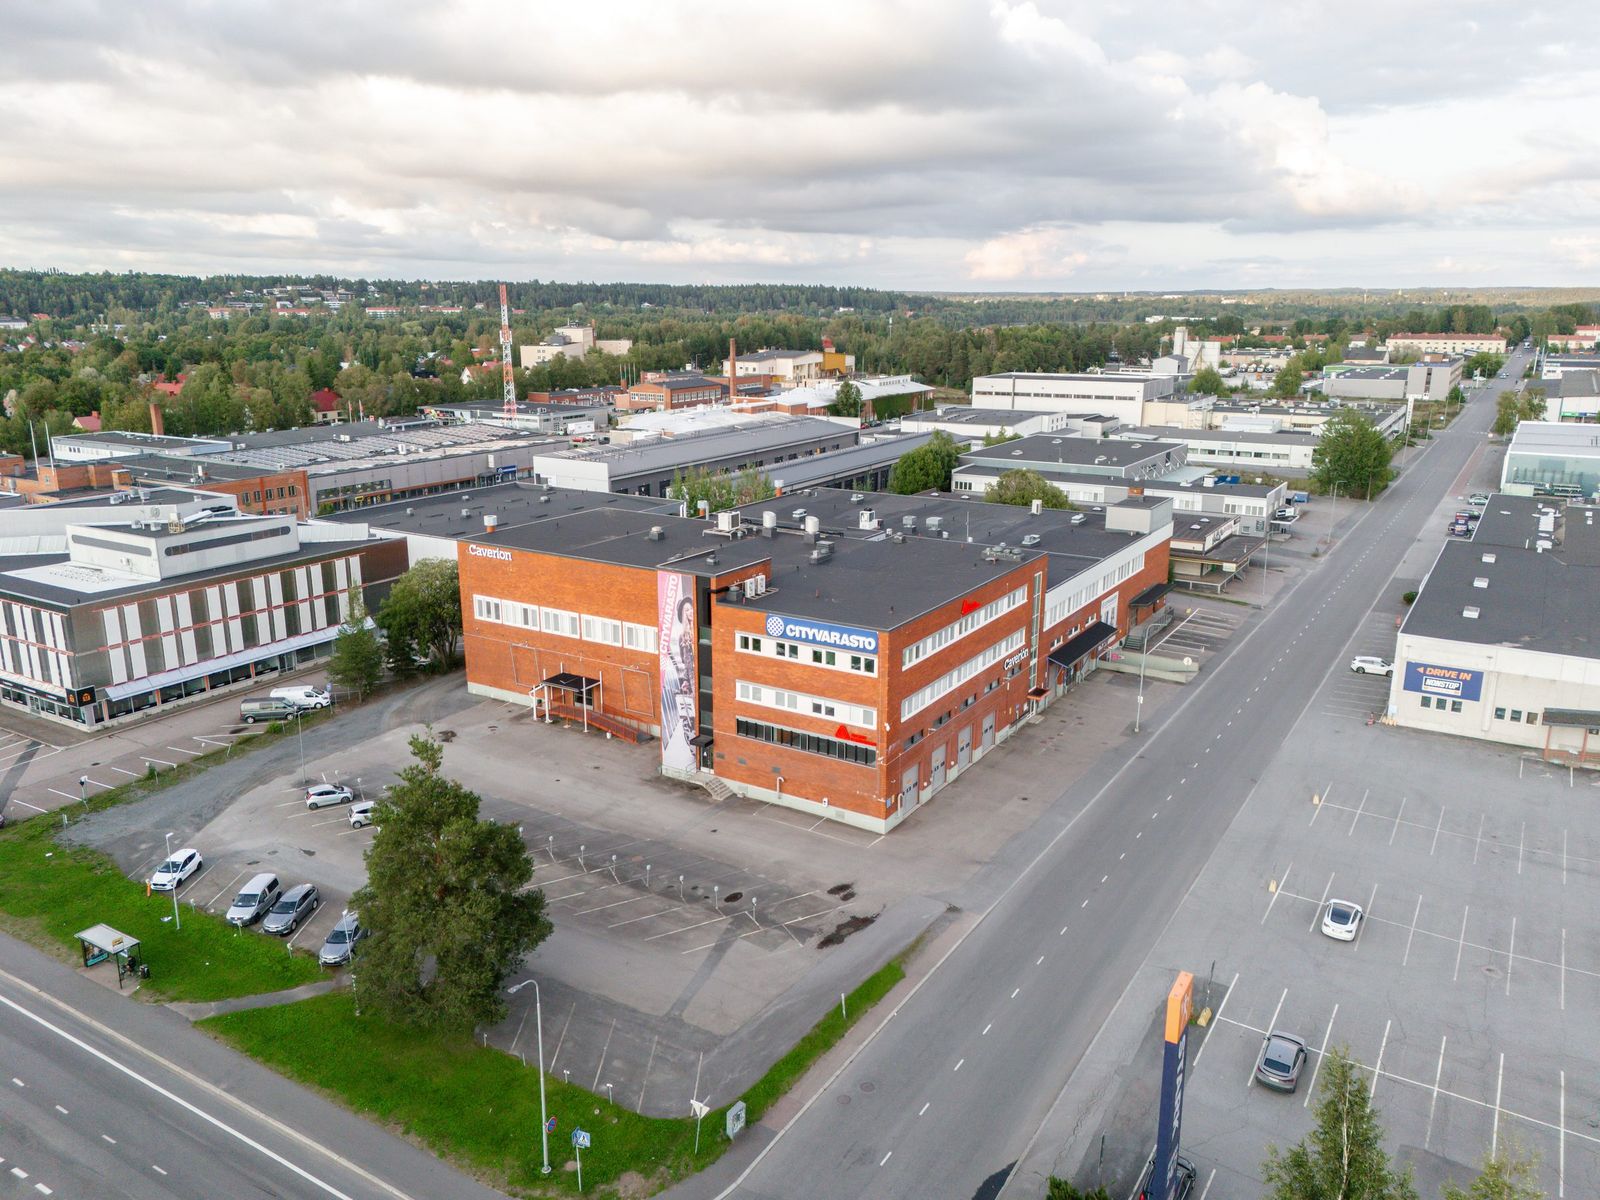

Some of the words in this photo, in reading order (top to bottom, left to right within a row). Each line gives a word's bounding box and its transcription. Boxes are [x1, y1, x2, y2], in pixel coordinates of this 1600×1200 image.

[469, 544, 513, 561] Caverion
[660, 574, 679, 654] CITYVARASTO
[785, 624, 876, 651] CITYVARASTO
[1003, 648, 1029, 670] Caverion
[1425, 667, 1458, 679] DRIVE
[1458, 671, 1472, 681] IN
[1425, 678, 1460, 689] NONSTOP
